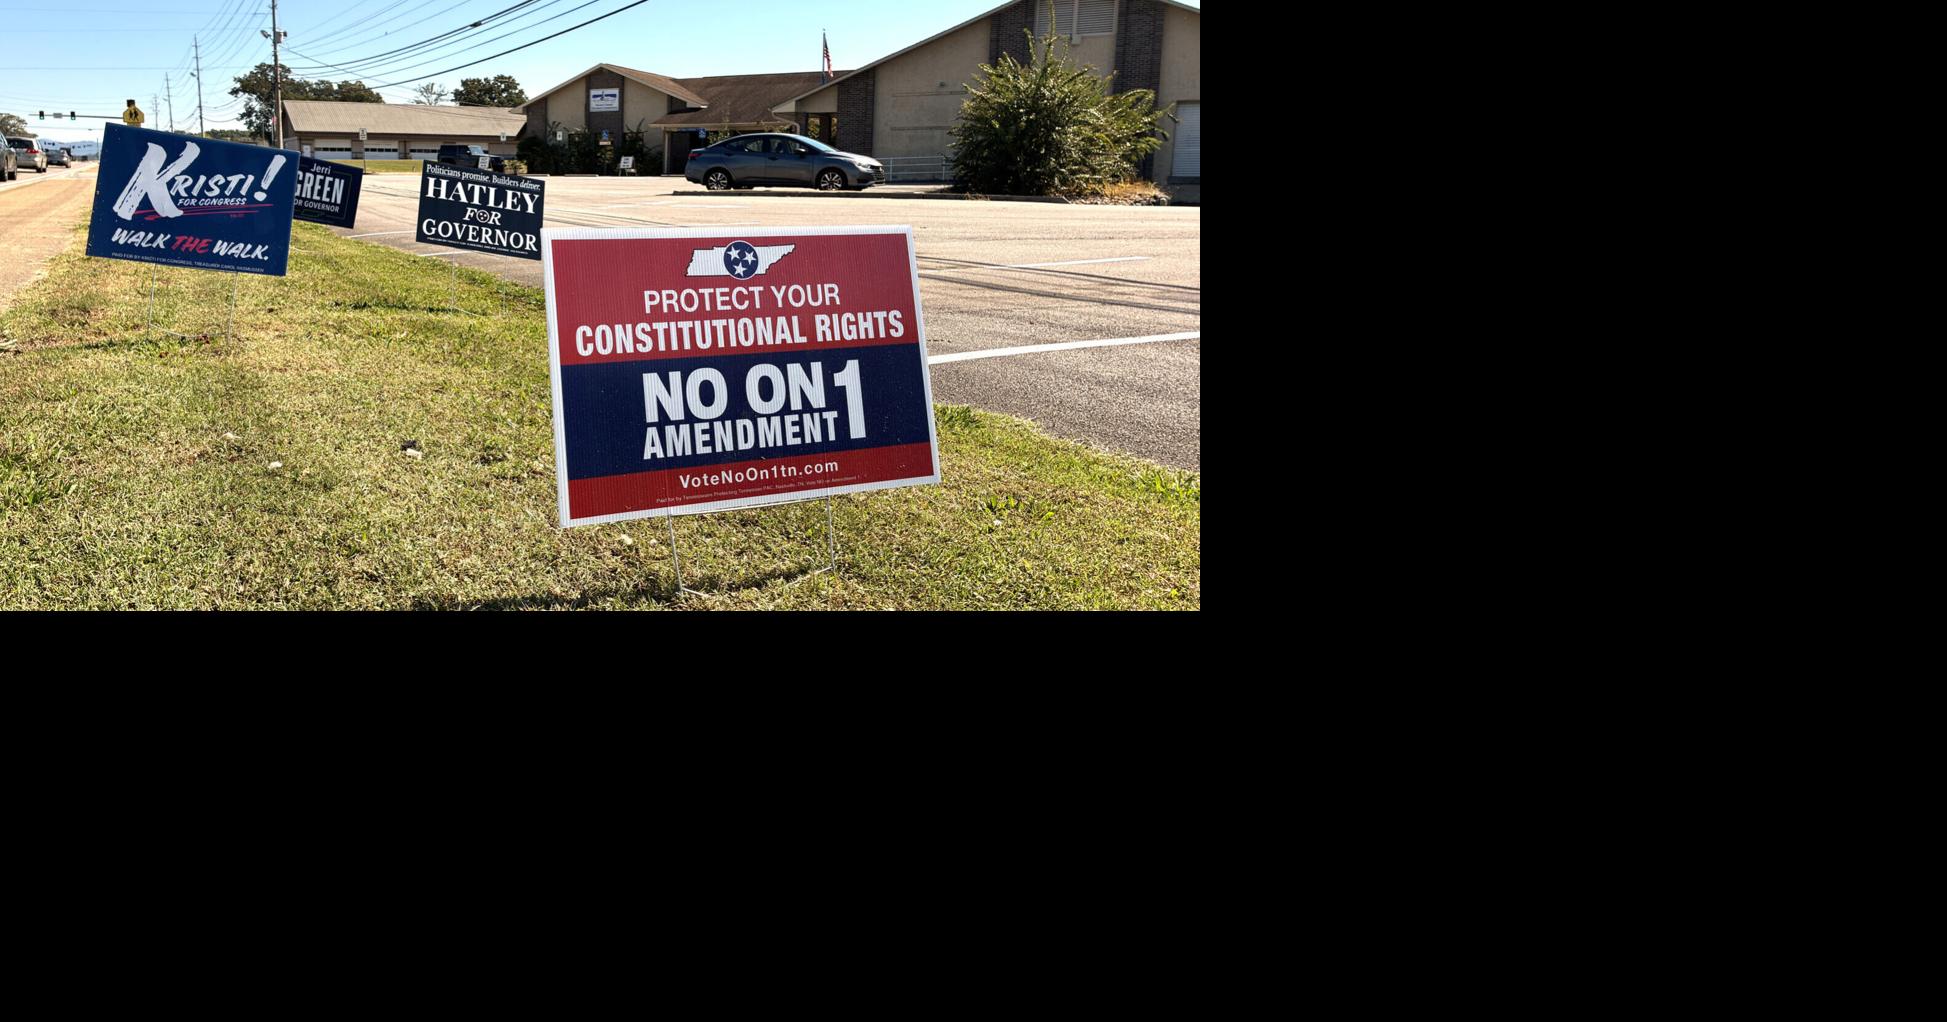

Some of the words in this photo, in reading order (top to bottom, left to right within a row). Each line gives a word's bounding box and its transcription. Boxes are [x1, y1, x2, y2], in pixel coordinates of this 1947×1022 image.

[112, 141, 287, 221] KRISTI!
[310, 163, 332, 175] Jerri
[426, 164, 461, 177] Politicians
[461, 171, 490, 183] promise.
[492, 174, 519, 187] Builders
[177, 198, 197, 206] FOR
[199, 197, 247, 206] CONGRESS
[294, 199, 303, 207] OR
[304, 200, 340, 213] GOVERNOR
[426, 176, 539, 214] HATLEY
[462, 207, 502, 225] FOR
[111, 227, 171, 249] WALK
[170, 235, 213, 254] THE
[212, 239, 270, 261] WALK.
[422, 218, 538, 252] GOVERNOR
[644, 286, 763, 314] PROTECT
[770, 283, 840, 308] YOUR
[575, 315, 807, 357] CONSTITUTIONAL
[814, 309, 904, 342] RIGHTS
[642, 367, 728, 423] NO
[745, 361, 826, 414] ON
[833, 359, 867, 440] 1
[643, 410, 839, 460] AMENDMENT
[679, 461, 839, 489] VoteNoOn1tn.com
